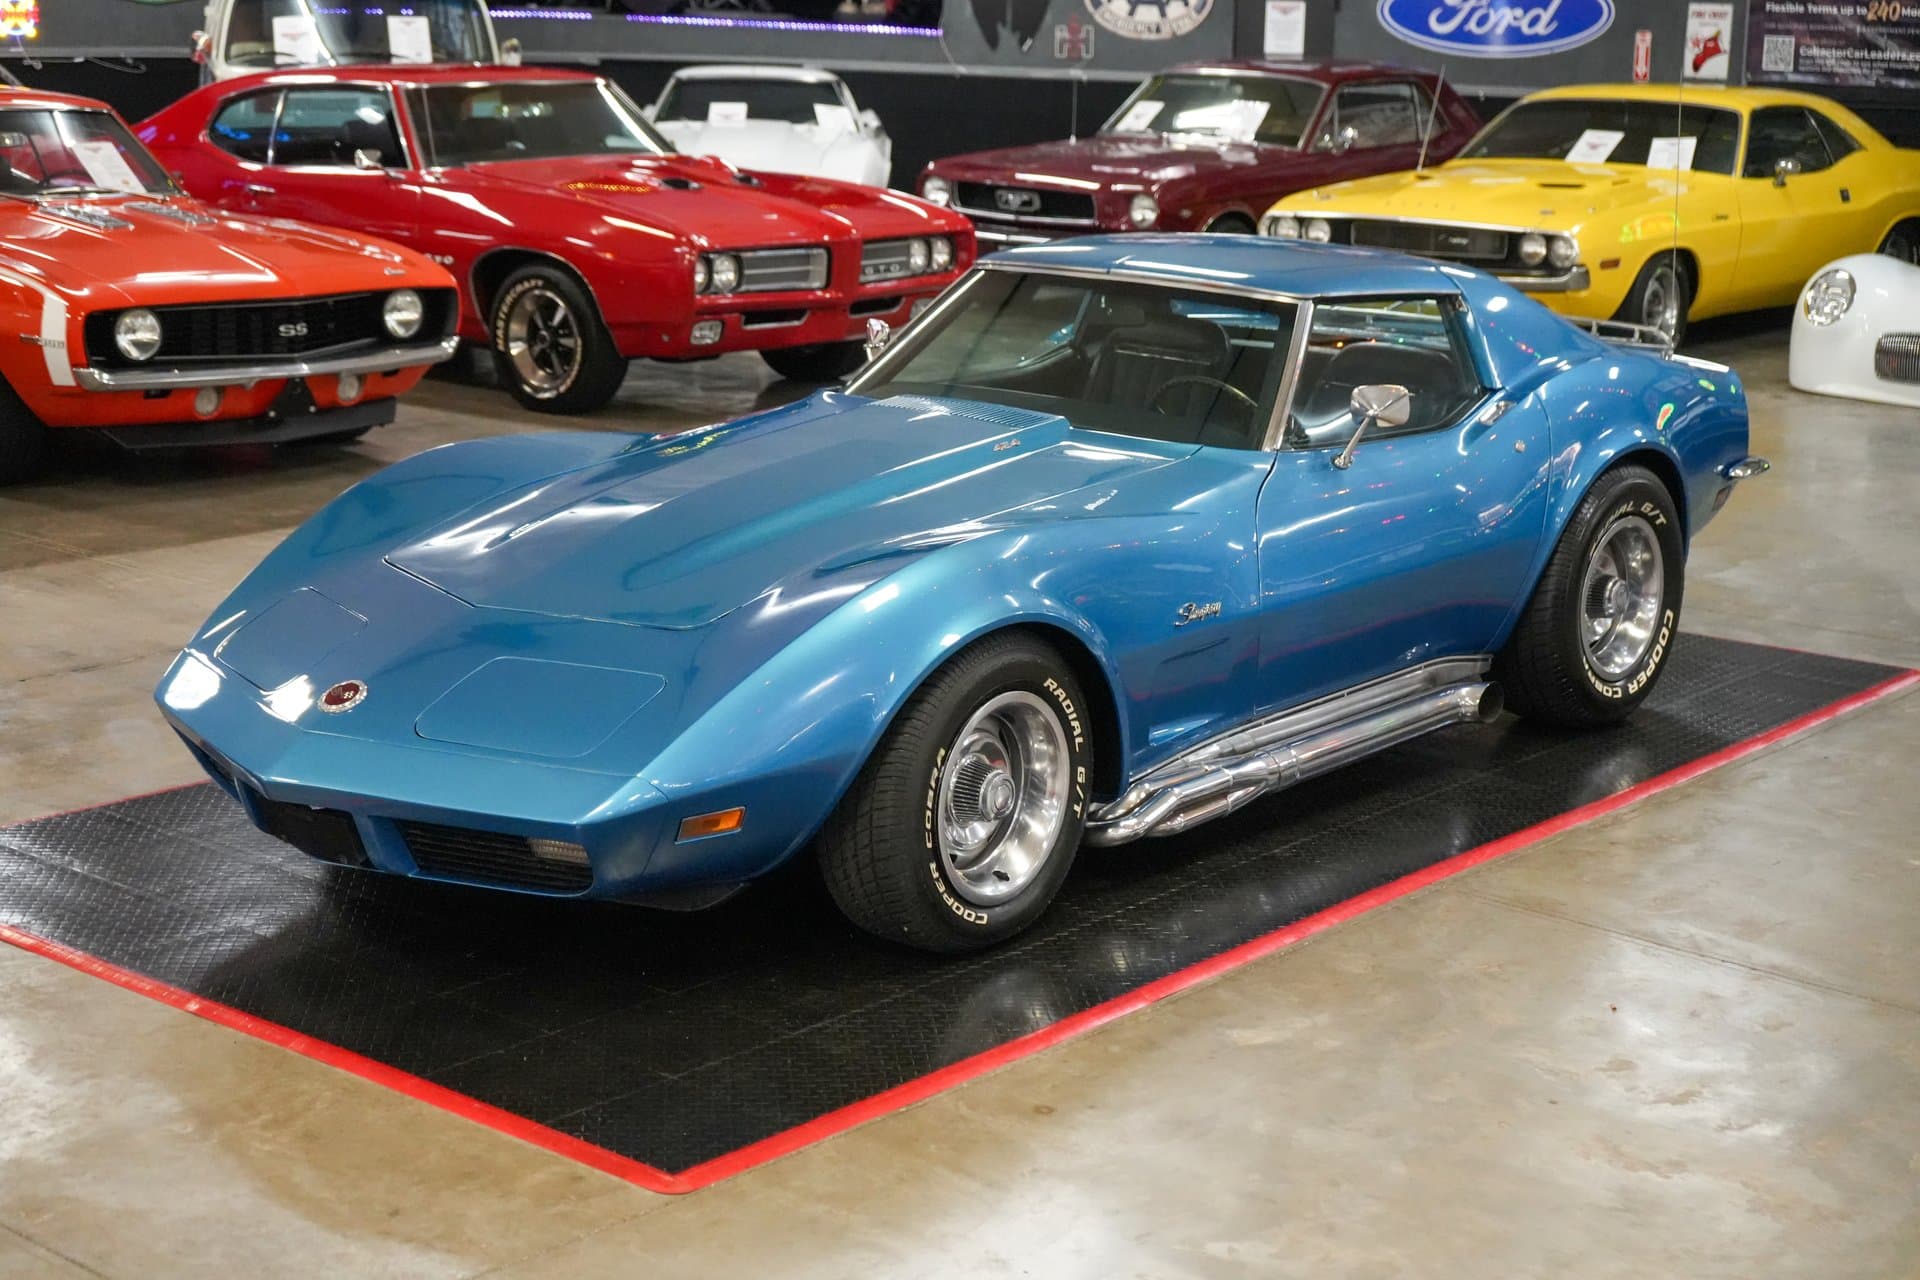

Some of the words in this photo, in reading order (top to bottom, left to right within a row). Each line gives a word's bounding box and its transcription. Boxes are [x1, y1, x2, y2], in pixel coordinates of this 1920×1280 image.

[1427, 0, 1559, 35] Ford
[1764, 1, 1805, 14] Flexible
[1807, 3, 1839, 15] Terms
[1840, 5, 1854, 17] up
[1856, 5, 1867, 16] to
[1866, 0, 1901, 22] 240
[1901, 6, 1920, 18] Mo
[864, 263, 901, 275] GTO
[278, 322, 308, 337] SS
[496, 278, 544, 352] MASTERCRAFT
[1640, 501, 1667, 526] G/T
[1627, 608, 1674, 695] COOPER
[1043, 677, 1084, 753] RADIAL
[1073, 766, 1086, 820] G/T
[924, 747, 946, 849] COBRA
[929, 861, 989, 926] COOPER
